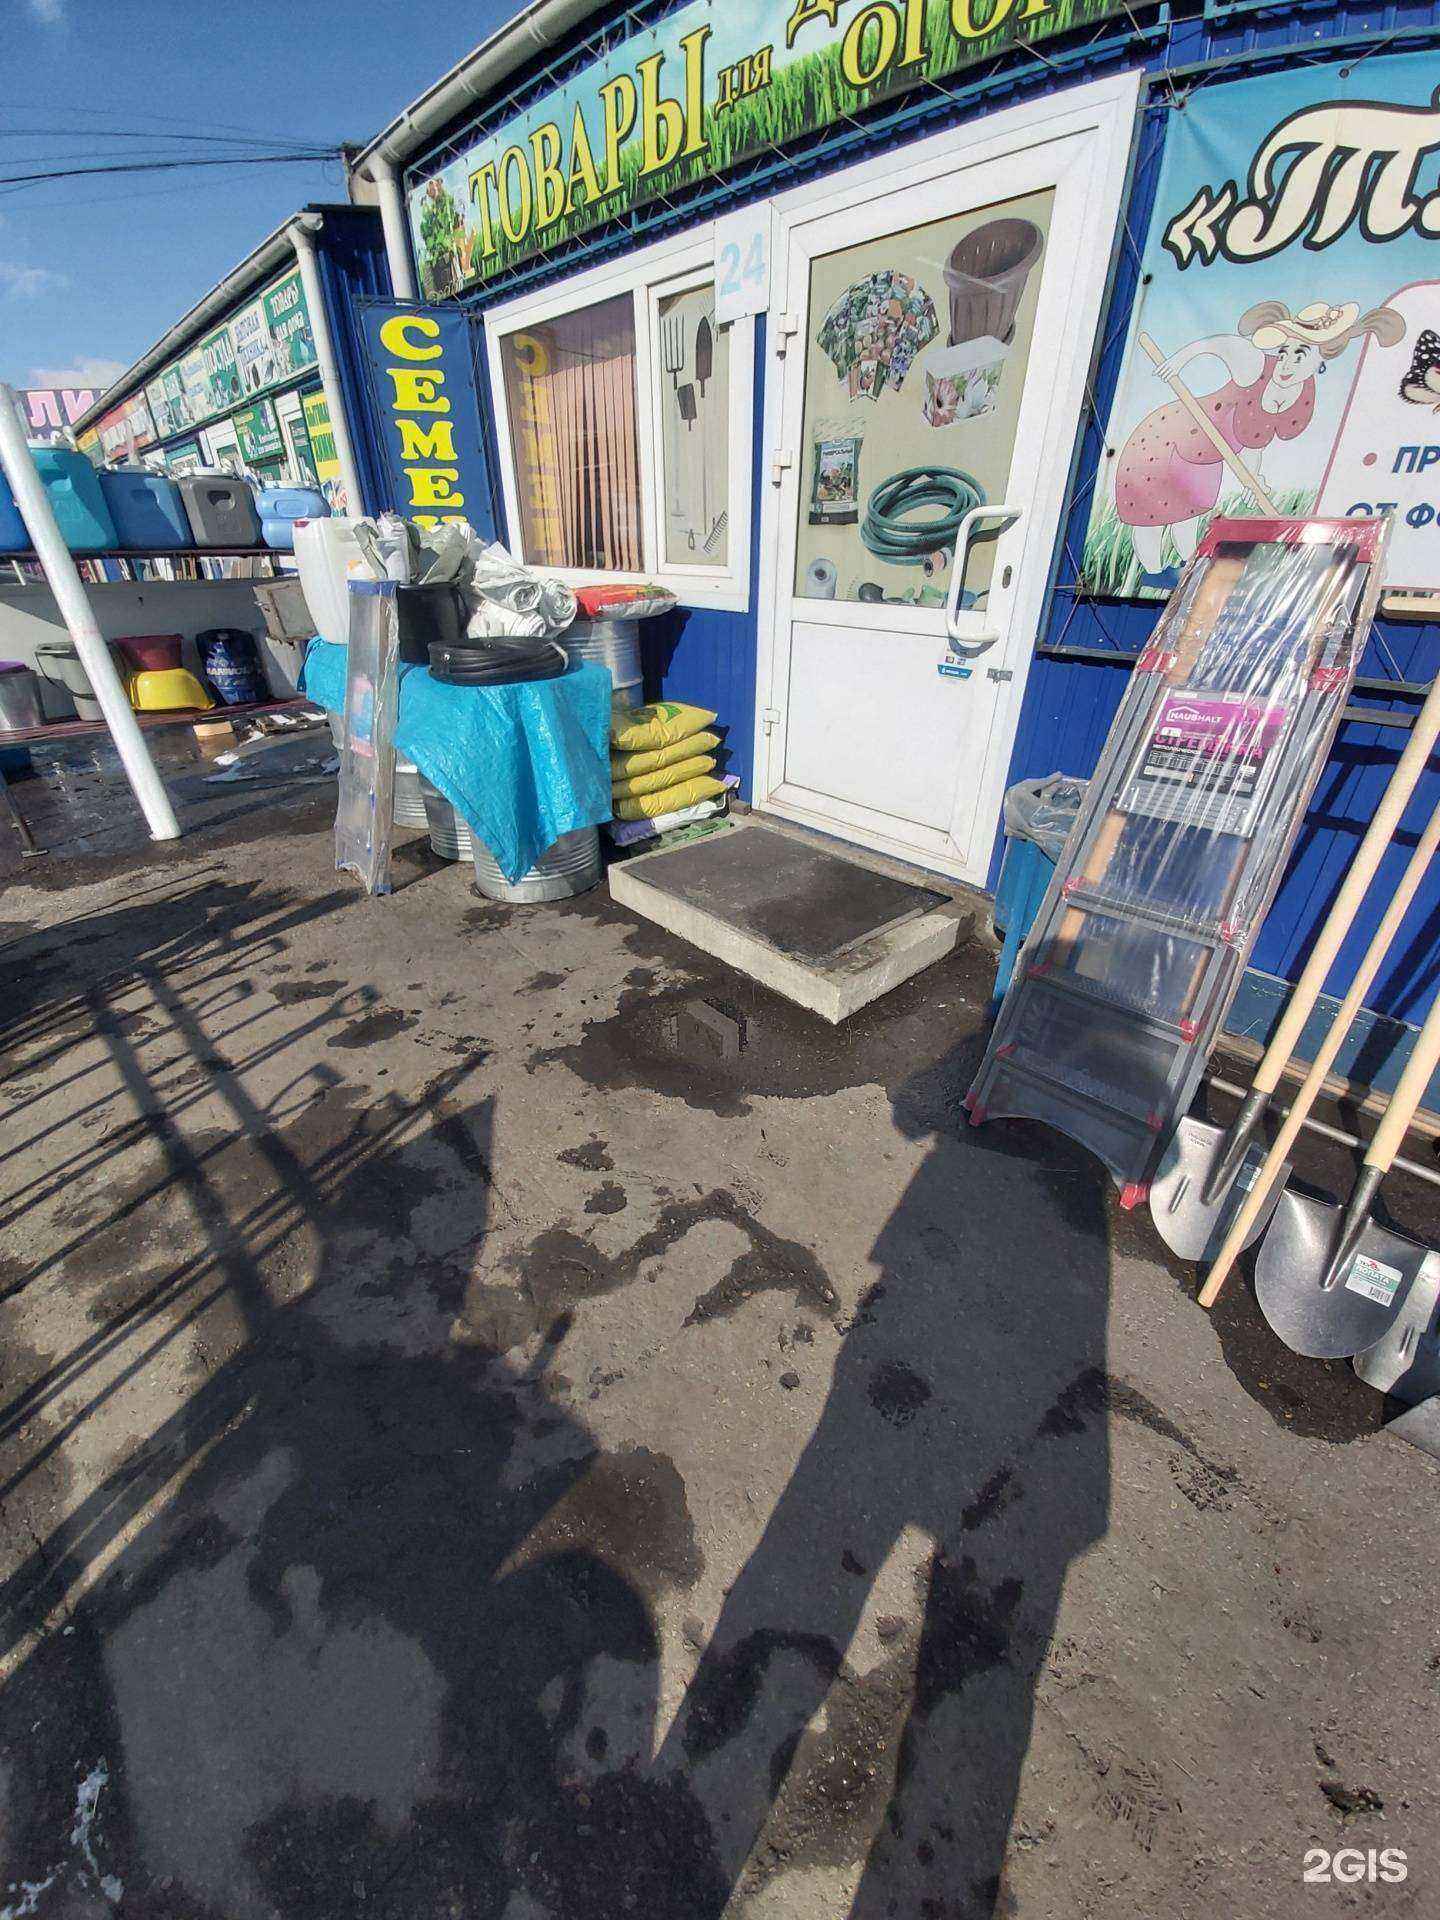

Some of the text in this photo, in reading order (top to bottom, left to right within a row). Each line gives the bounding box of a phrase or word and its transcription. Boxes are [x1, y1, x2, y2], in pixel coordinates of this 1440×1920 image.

[468, 23, 712, 259] ТОВАРЫ
[1161, 84, 1440, 271] «Т
[720, 232, 765, 296] 24
[1405, 502, 1440, 529] Ф
